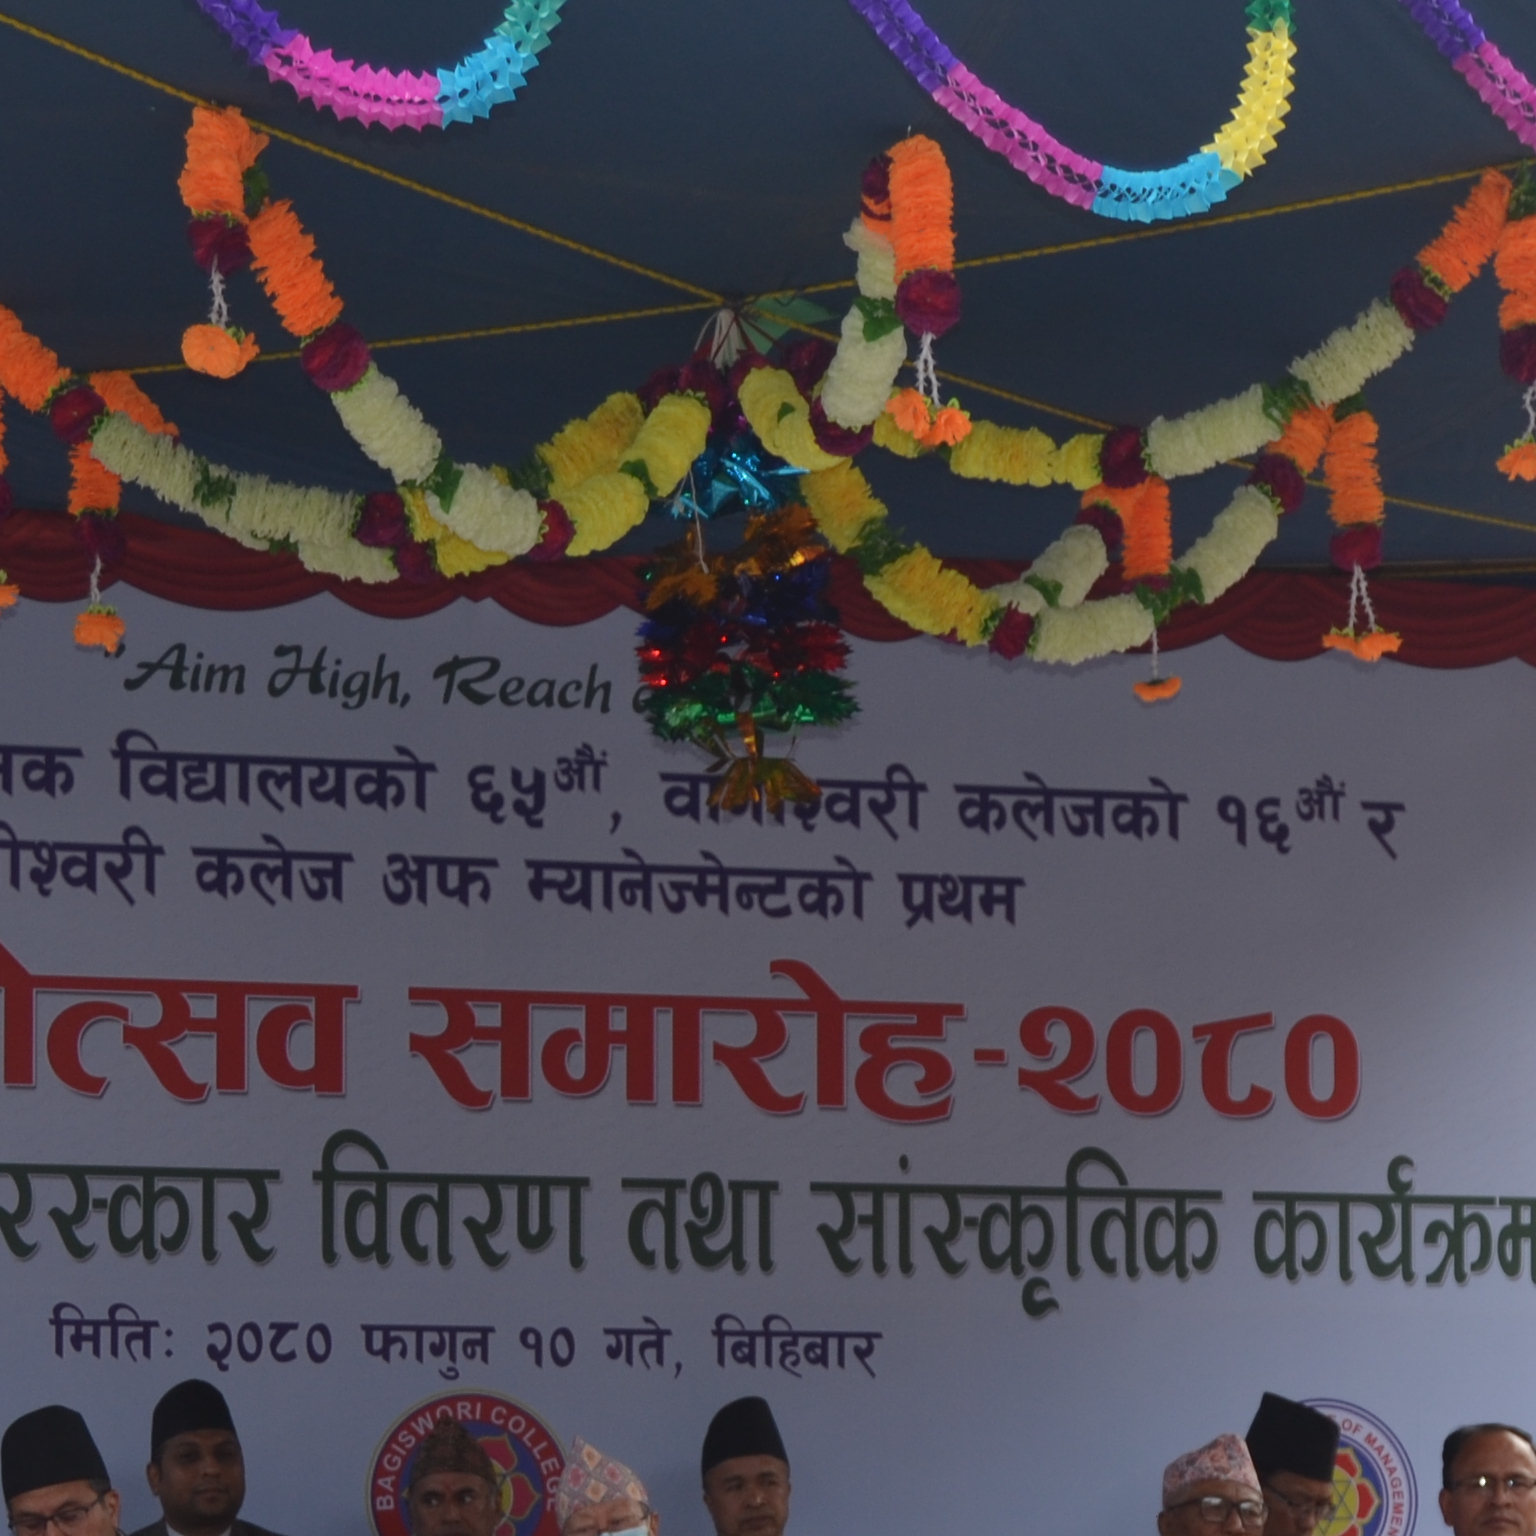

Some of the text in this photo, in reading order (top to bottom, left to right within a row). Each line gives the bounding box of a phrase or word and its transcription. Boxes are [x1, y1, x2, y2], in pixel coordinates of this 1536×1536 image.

[267, 644, 411, 711] High,
[433, 654, 612, 714] Reach
[111, 729, 437, 812] विद्यालयको
[954, 772, 1188, 843] कलेजको
[1361, 801, 1405, 859] र
[192, 834, 354, 906] कलेज
[383, 853, 499, 907] अफ
[525, 848, 873, 920] म्यानेज्मेन्टको
[897, 873, 1025, 928] प्रथम
[408, 960, 1360, 1122] समारोह-२०८०
[312, 1129, 590, 1271] वितरण
[621, 1172, 779, 1275] तथा
[810, 1147, 1222, 1319] सांस्कृतिक
[207, 1322, 332, 1372] २०८०
[361, 1324, 496, 1380] फागुन
[520, 1327, 575, 1367] १०
[603, 1316, 682, 1378] गते,
[711, 1314, 883, 1378] बिहिबार
[1342, 1418, 1363, 1435] OF
